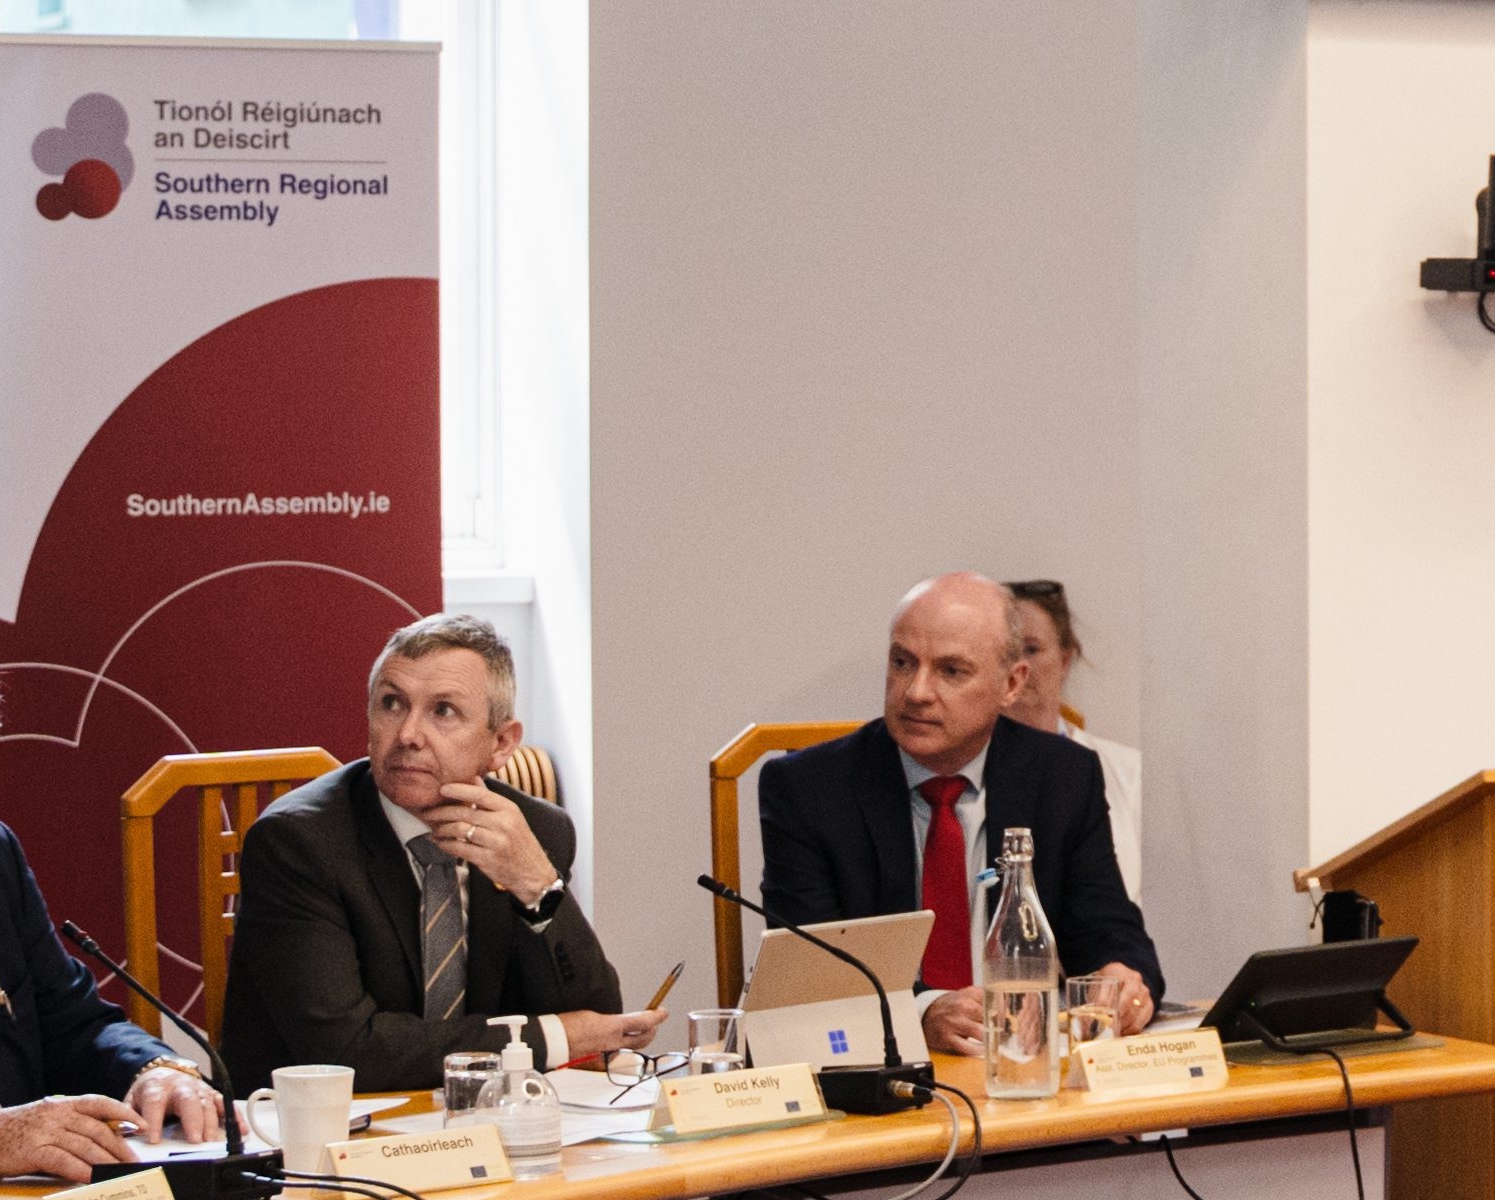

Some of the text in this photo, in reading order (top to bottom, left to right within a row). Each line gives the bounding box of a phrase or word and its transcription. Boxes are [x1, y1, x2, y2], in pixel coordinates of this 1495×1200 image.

[154, 99, 382, 128] Tionól Réigiúnach
[154, 128, 290, 149] an Deiscirt
[155, 171, 388, 200] Southern Regional
[155, 199, 279, 227] Assembly
[125, 491, 391, 519] SouthernAssembly.ie
[1126, 1039, 1196, 1056] Enda Hogan
[714, 1078, 748, 1094] David
[751, 1076, 781, 1090] Kelly
[725, 1095, 763, 1109] Director
[381, 1135, 474, 1159] Cathaoirleach
